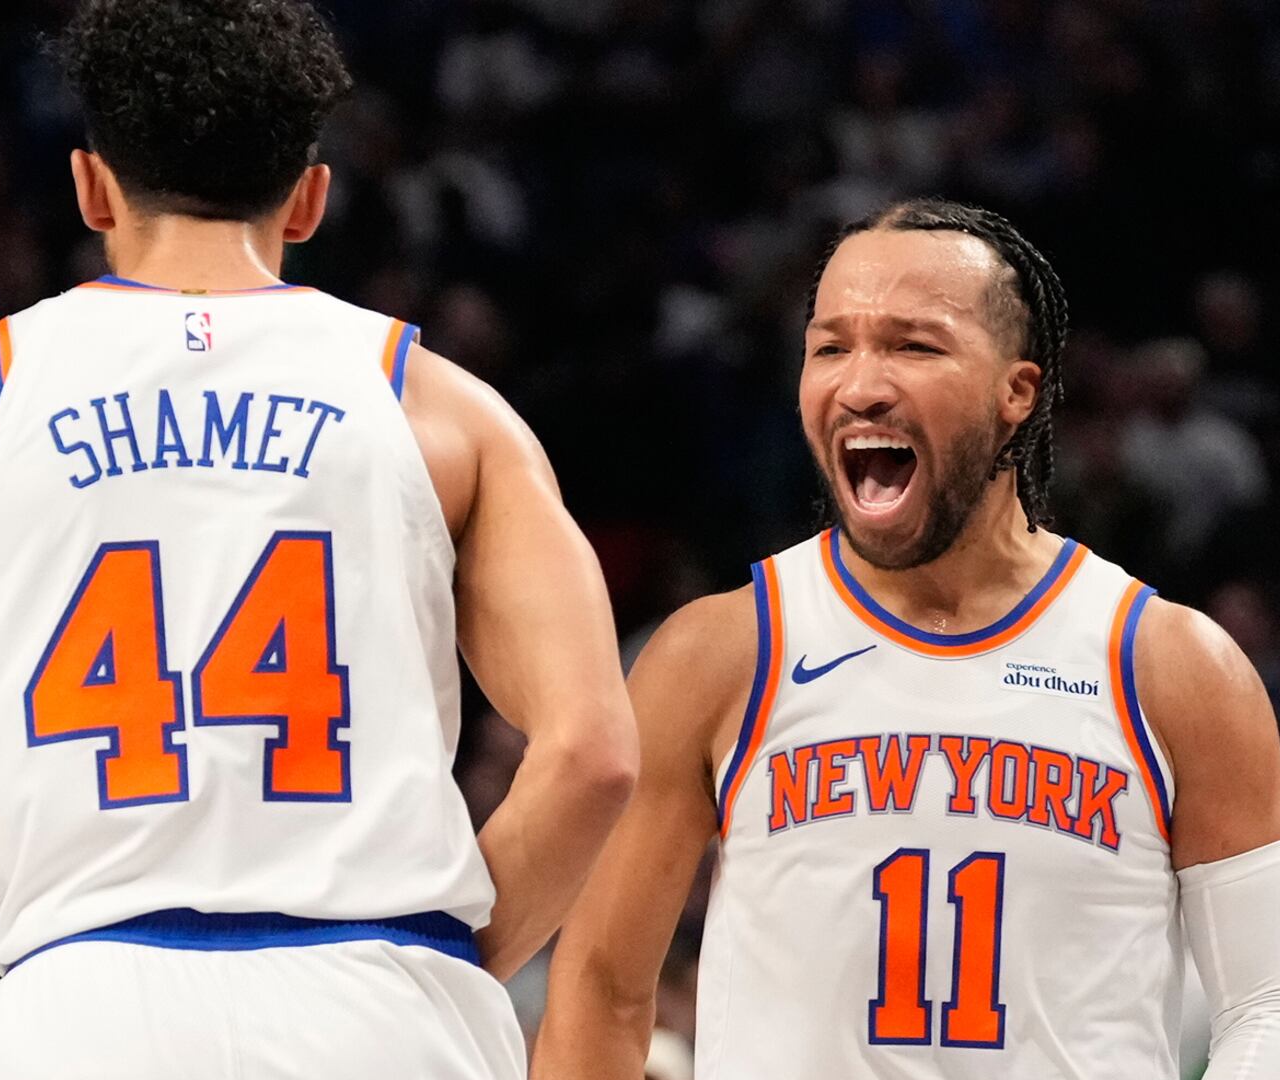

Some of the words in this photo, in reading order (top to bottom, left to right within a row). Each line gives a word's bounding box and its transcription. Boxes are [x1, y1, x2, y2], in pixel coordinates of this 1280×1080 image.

[48, 388, 345, 489] SHAMET
[24, 530, 352, 810] 44
[1003, 672, 1040, 688] abu
[1006, 662, 1057, 674] experience
[767, 732, 930, 838] NEW
[937, 733, 1129, 855] YORK
[868, 847, 1006, 1050] 11
